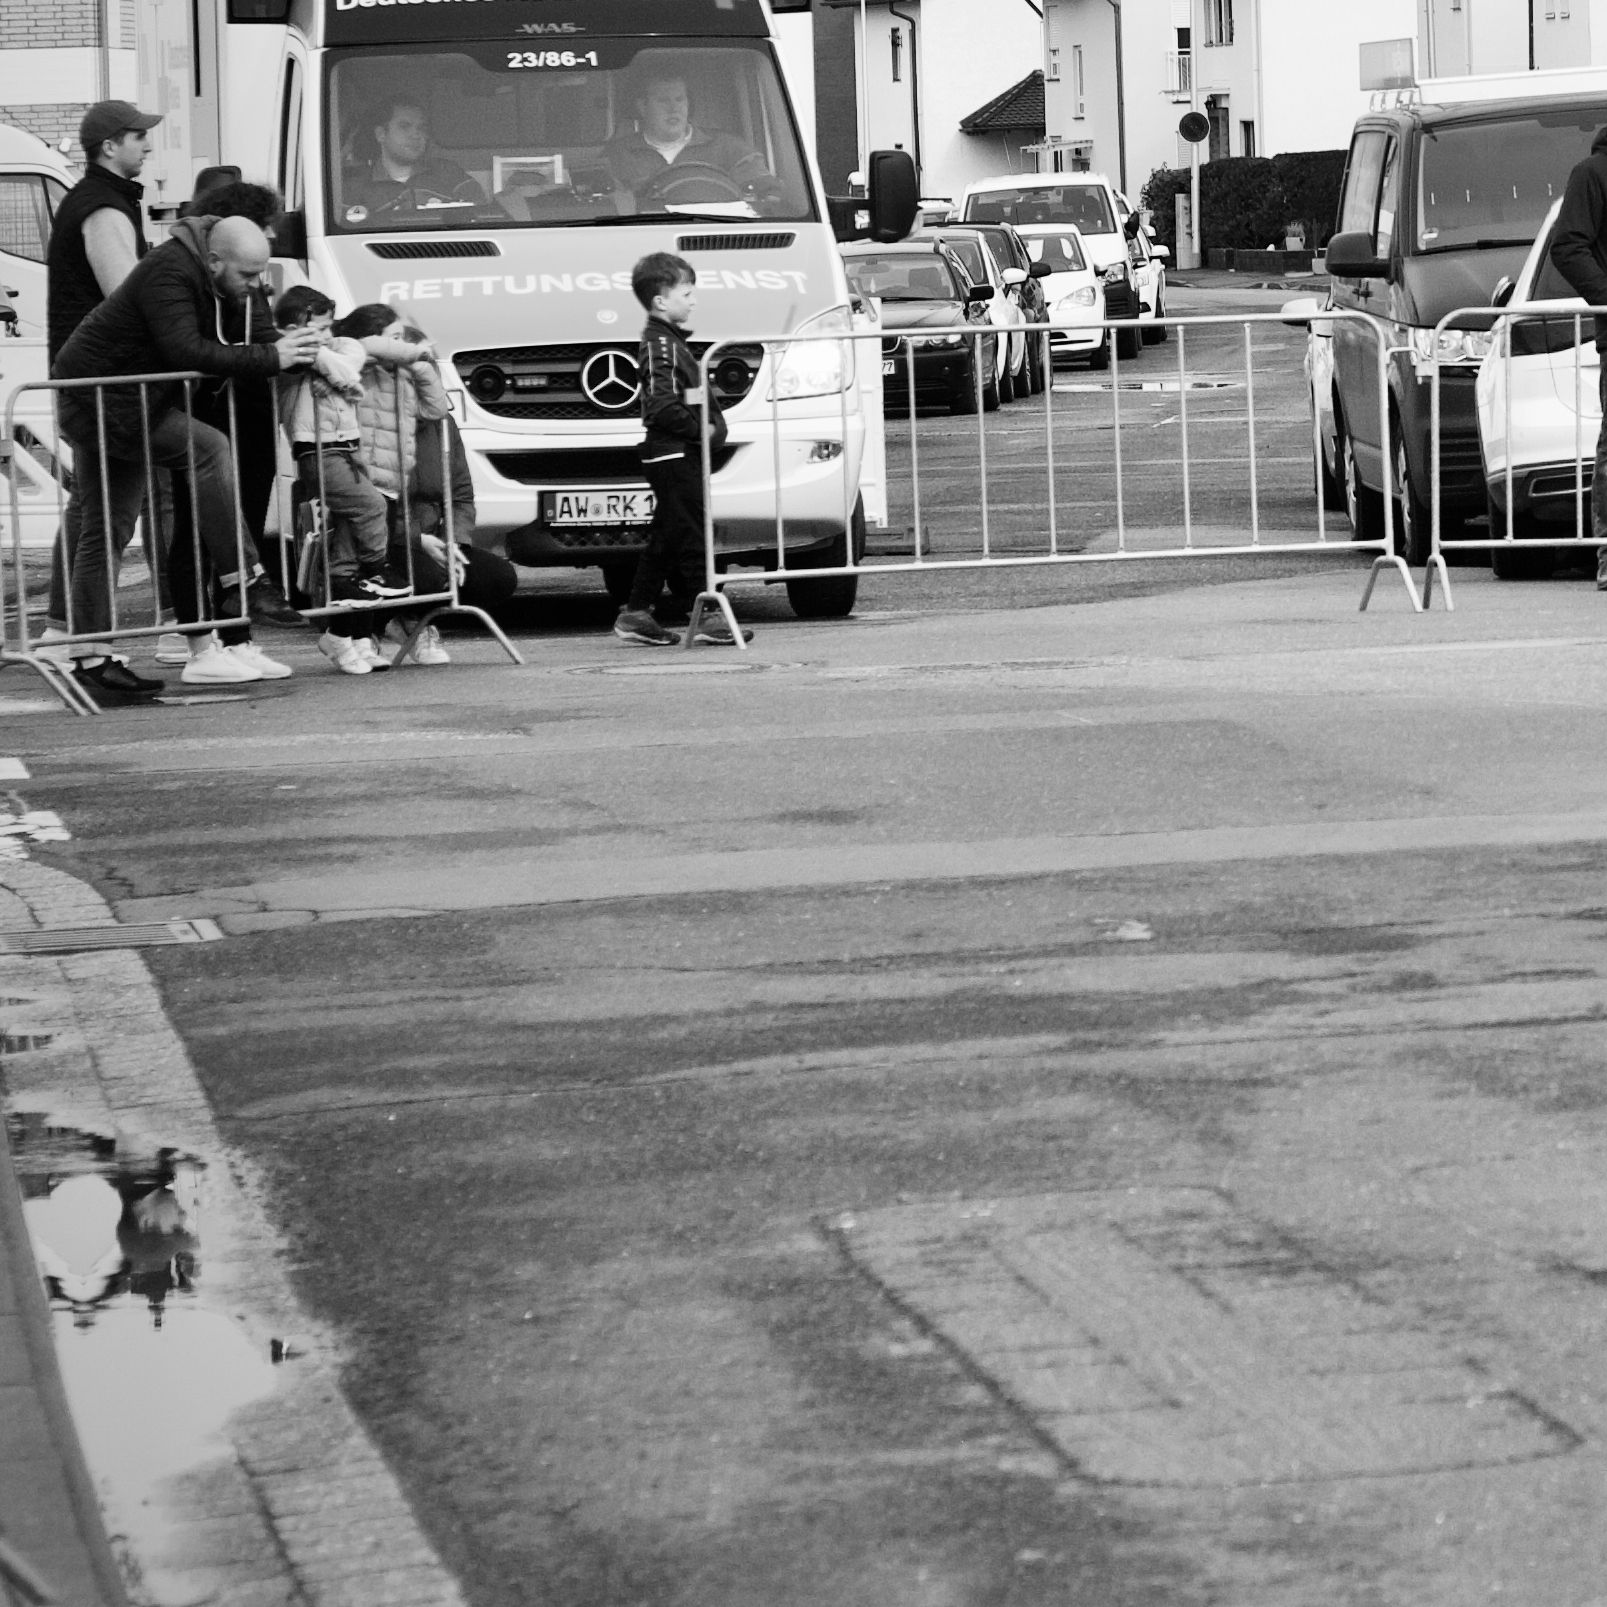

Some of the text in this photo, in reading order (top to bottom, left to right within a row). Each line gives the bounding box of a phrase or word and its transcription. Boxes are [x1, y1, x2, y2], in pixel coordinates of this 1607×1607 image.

[507, 50, 599, 69] 23/86-1
[380, 269, 809, 306] RETTUNGSENST
[559, 496, 589, 519] AW
[607, 494, 638, 518] RK
